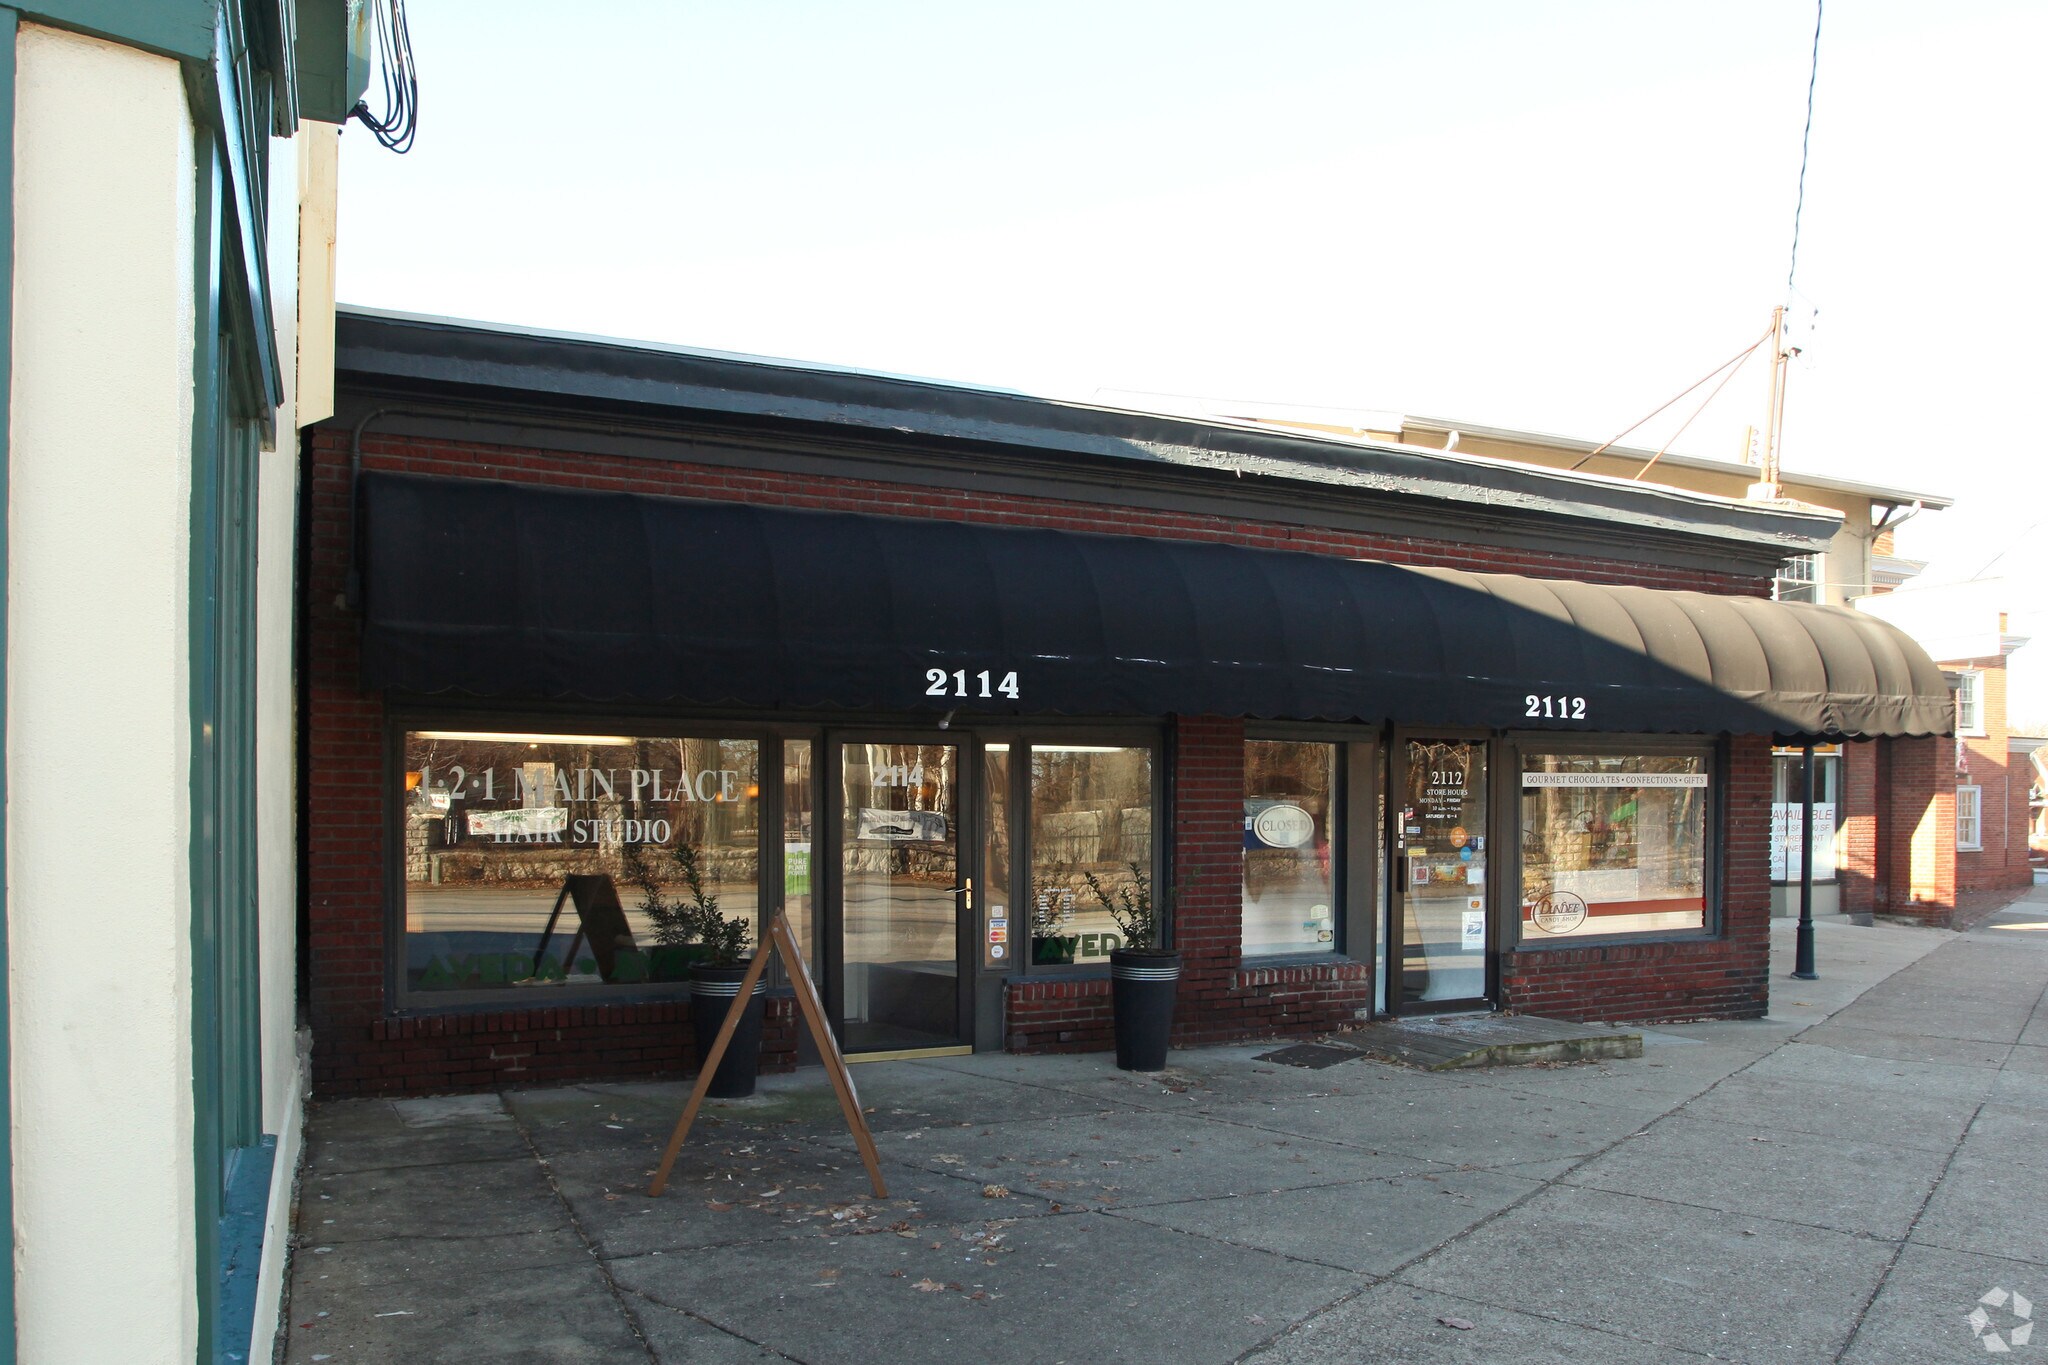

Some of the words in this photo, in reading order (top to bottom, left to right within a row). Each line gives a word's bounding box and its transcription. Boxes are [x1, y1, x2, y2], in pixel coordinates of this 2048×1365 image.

[926, 668, 1019, 699] 2114
[1525, 694, 1586, 720] 2112
[512, 767, 615, 802] MAIN
[628, 769, 740, 803] PLACE
[873, 764, 923, 787] 2114
[1431, 771, 1463, 785] 2112
[1526, 775, 1566, 784] GOURMET
[1568, 775, 1620, 784] CHOCOLATES
[1625, 776, 1678, 784] CONFECTIONS
[1262, 820, 1310, 832] CLOSED
[1772, 809, 1832, 821] AVAILBLE
[492, 818, 563, 845] HAIR
[573, 819, 671, 845] STUDIO
[1038, 933, 1131, 960] AVED
[417, 952, 568, 986] AVEDA
